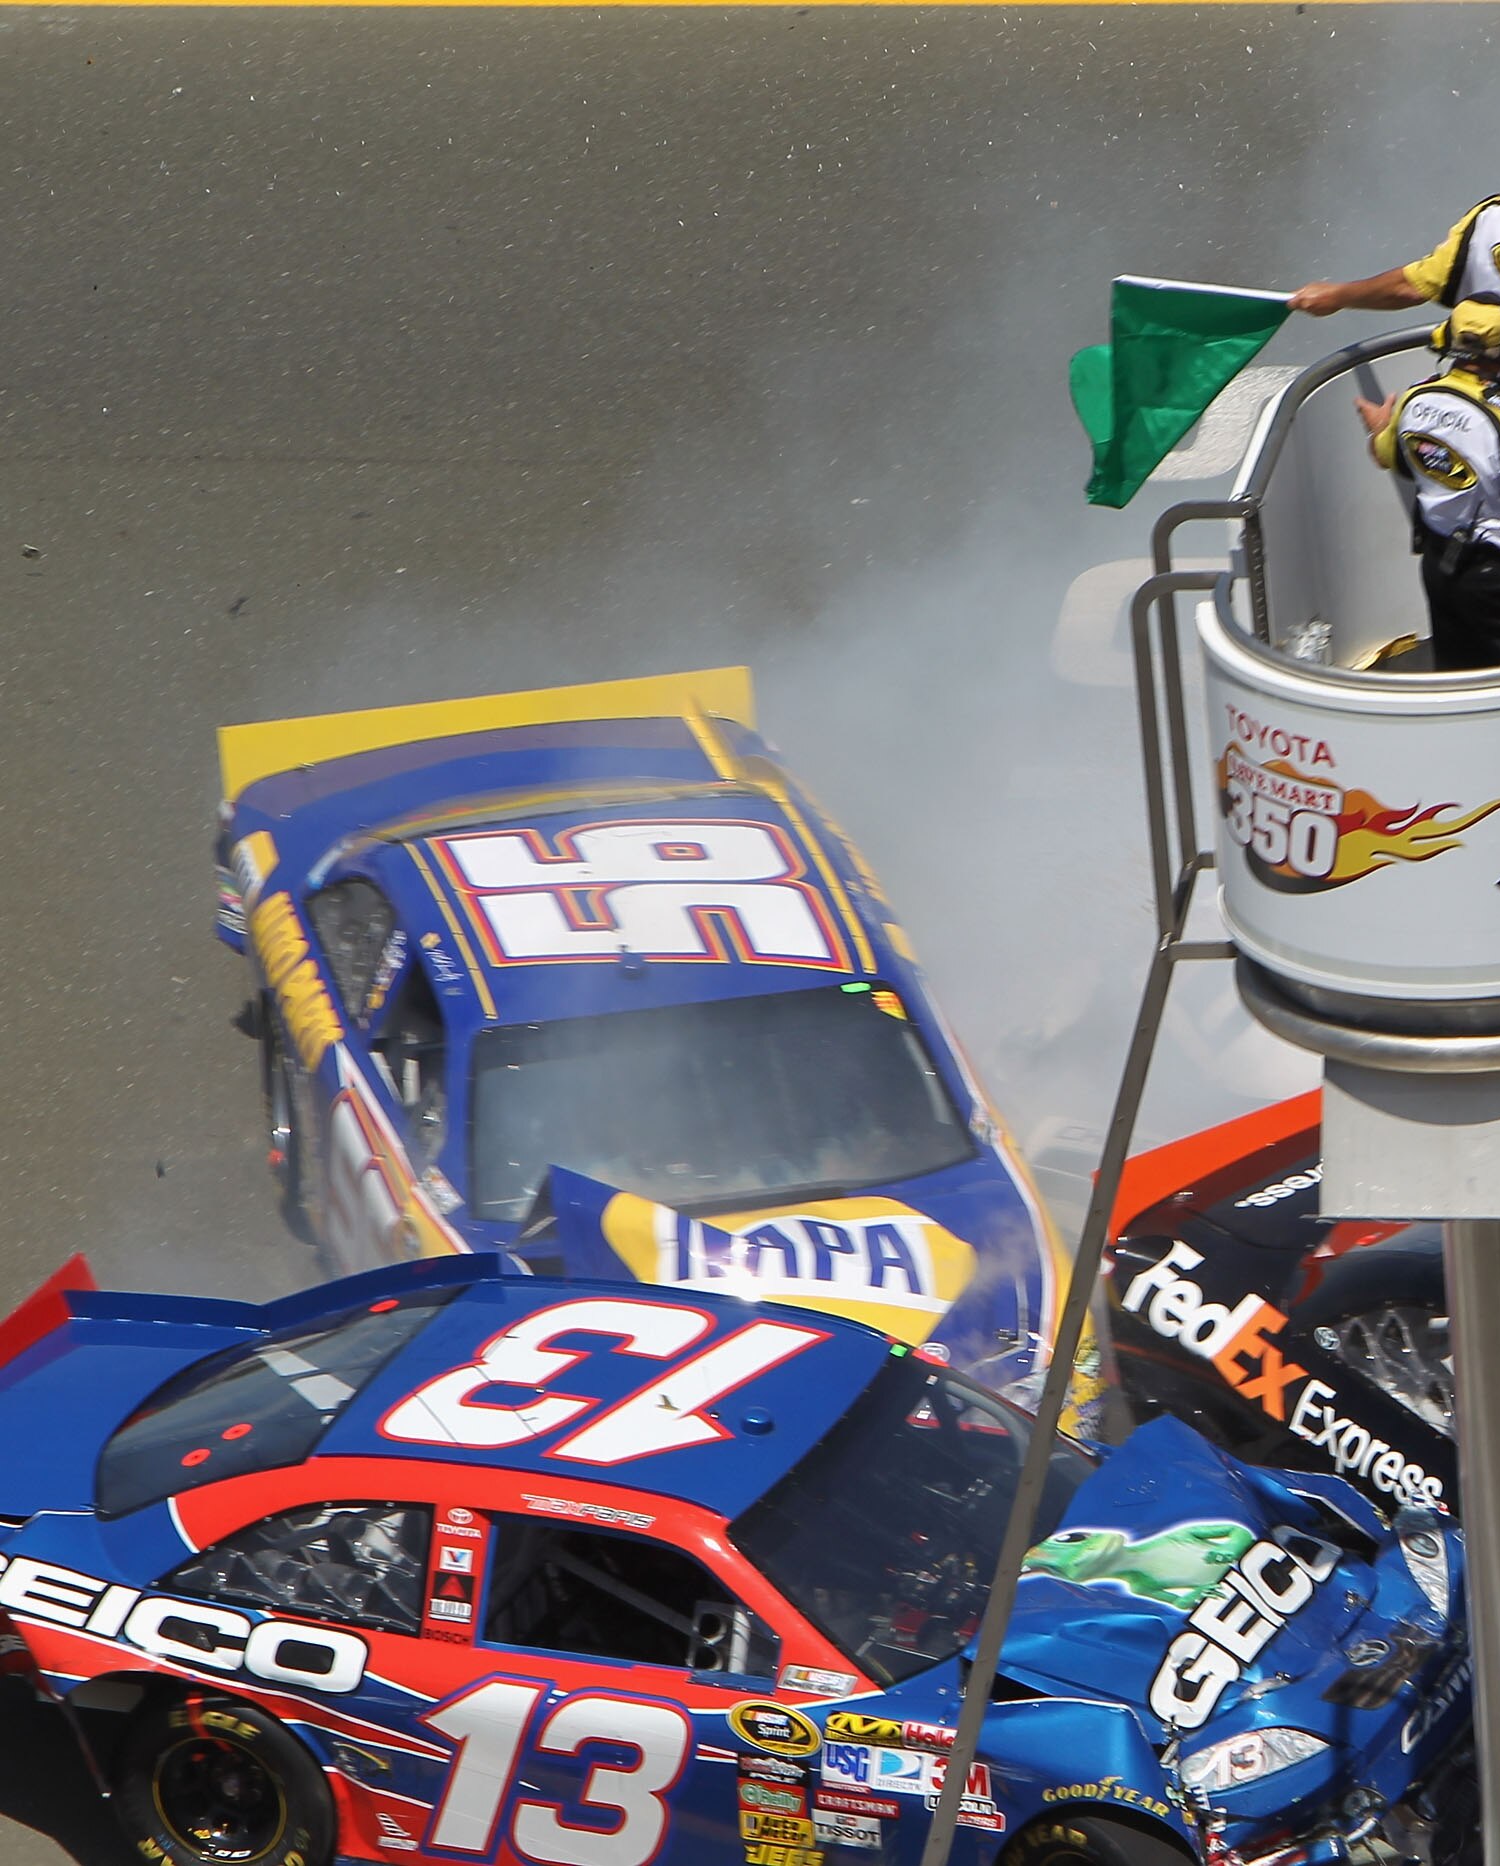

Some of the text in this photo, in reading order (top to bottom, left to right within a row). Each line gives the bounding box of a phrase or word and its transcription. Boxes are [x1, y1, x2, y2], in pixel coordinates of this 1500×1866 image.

[1412, 402, 1472, 433] OFFICIAL
[1225, 702, 1336, 768] TOYOTA
[1270, 777, 1335, 811] MART
[1225, 777, 1338, 878] 350
[428, 818, 854, 973] 56
[1121, 1239, 1310, 1422] FedEx
[377, 1298, 832, 1467] 13
[1288, 1379, 1451, 1513] Express
[0, 1553, 368, 1694] EICO
[1150, 1525, 1343, 1728] GEICO
[758, 1723, 791, 1741] Sprint
[826, 1743, 870, 1783] USG
[1192, 1729, 1267, 1788] 13
[418, 1675, 692, 1866] 13
[763, 1816, 799, 1831] Auto
[816, 1822, 880, 1843] TISSOT
[817, 1793, 897, 1816] CRAFTSMAN
[745, 1843, 824, 1866] JEGS
